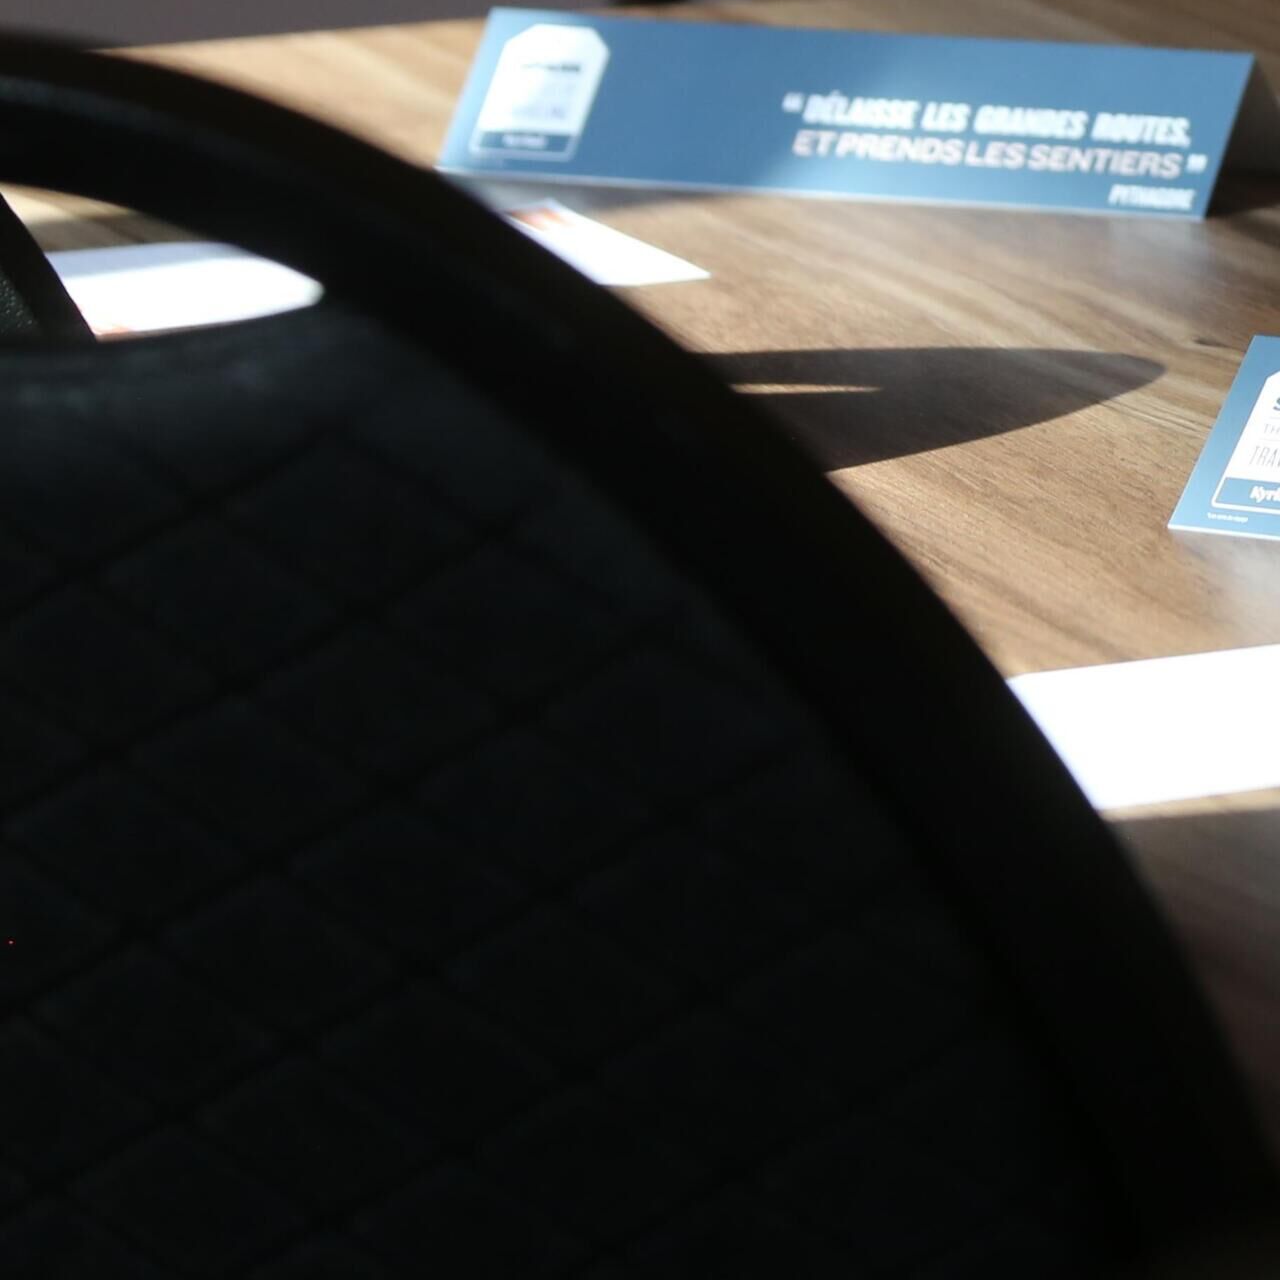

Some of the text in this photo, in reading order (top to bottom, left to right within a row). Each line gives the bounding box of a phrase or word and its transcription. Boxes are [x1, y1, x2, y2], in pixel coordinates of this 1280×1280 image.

[792, 128, 837, 158] ET
[834, 131, 965, 166] PRENDS
[963, 139, 1027, 170] LES
